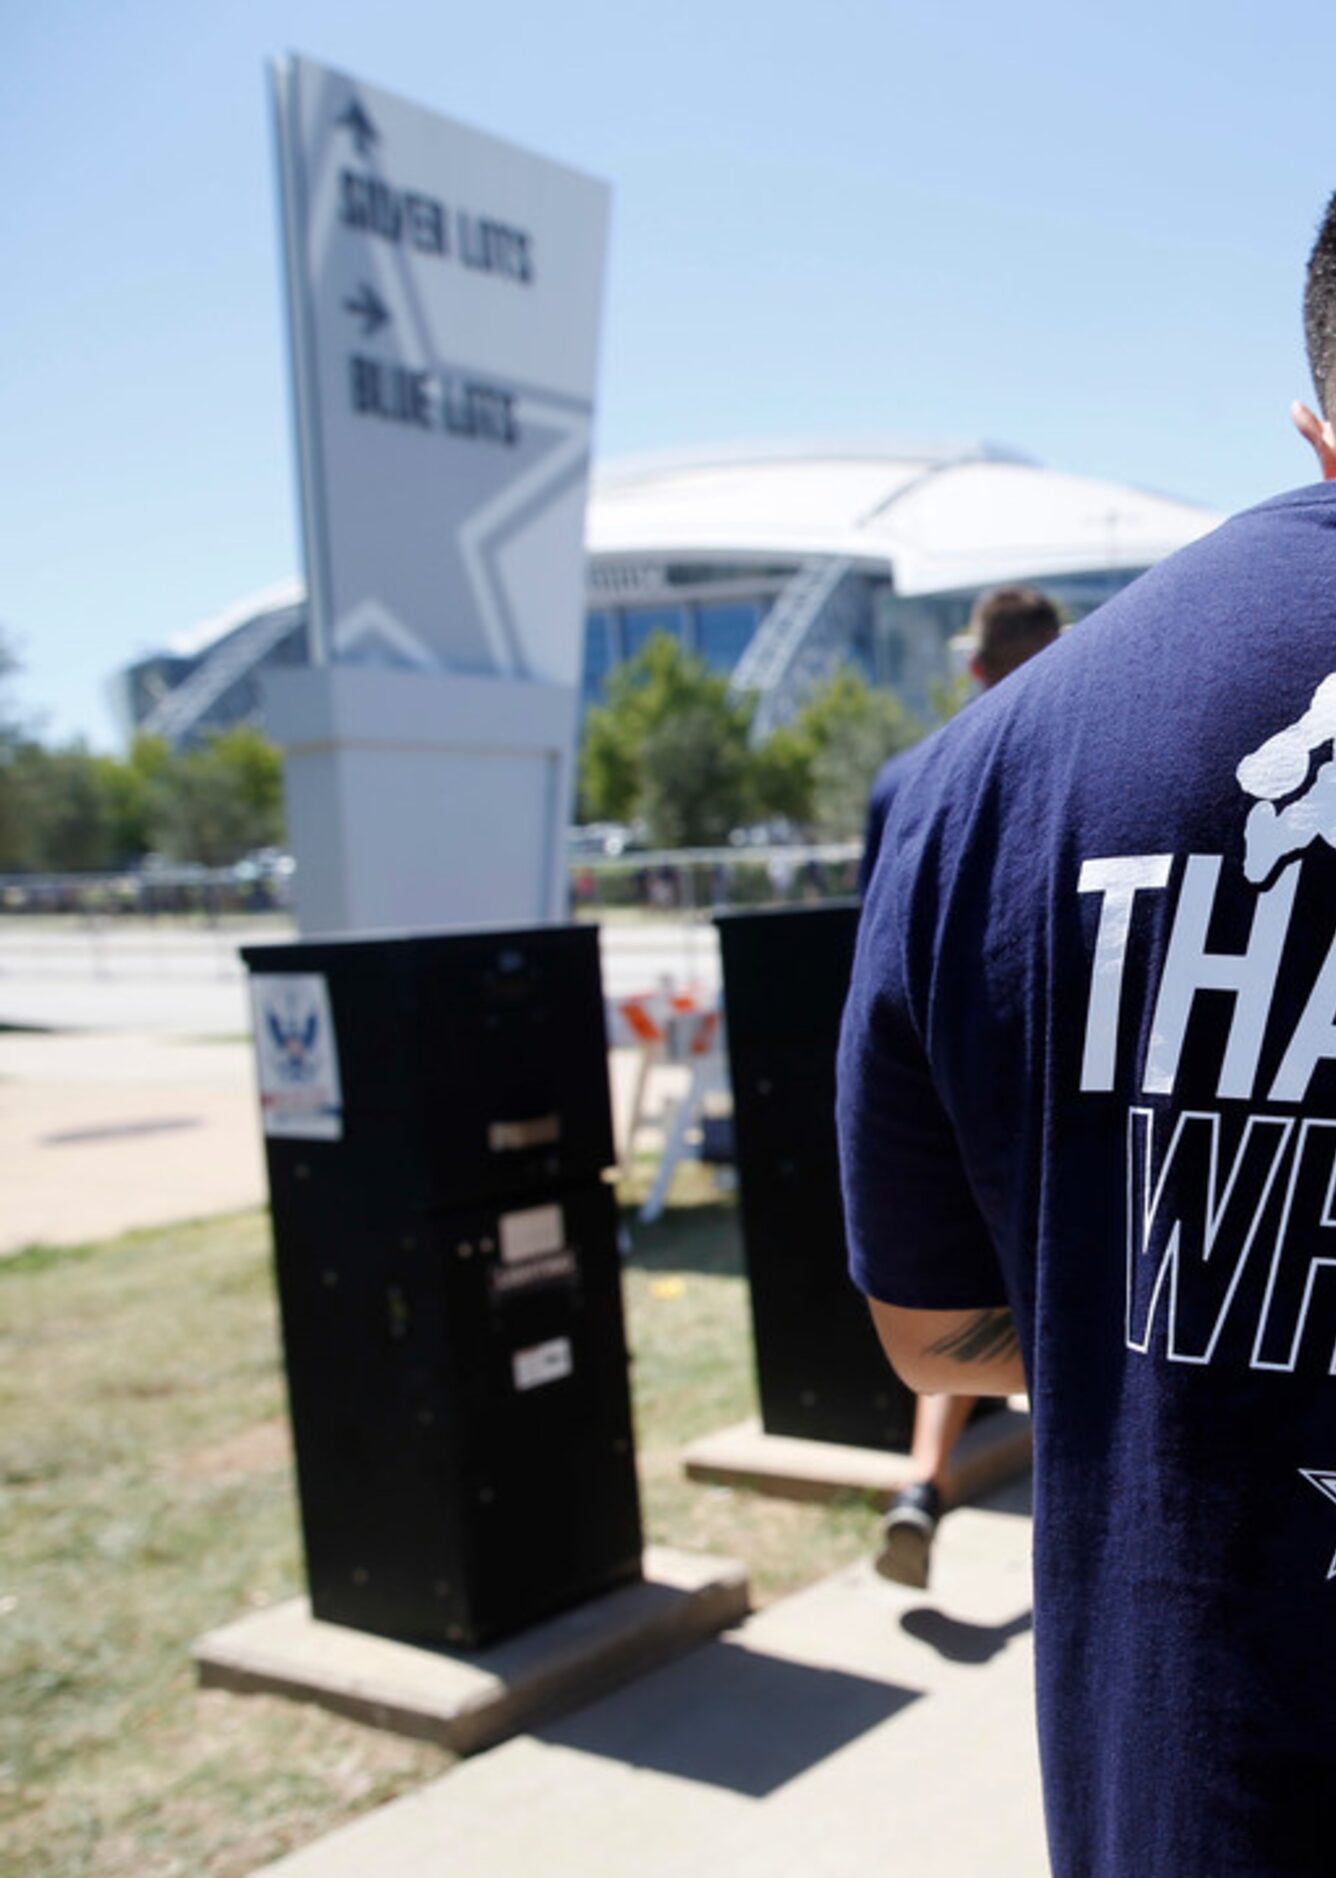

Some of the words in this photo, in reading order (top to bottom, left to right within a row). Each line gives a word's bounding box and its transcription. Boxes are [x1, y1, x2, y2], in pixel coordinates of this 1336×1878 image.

[456, 208, 534, 286] LOTS
[350, 353, 433, 431] BLUE
[440, 376, 518, 447] LOTS
